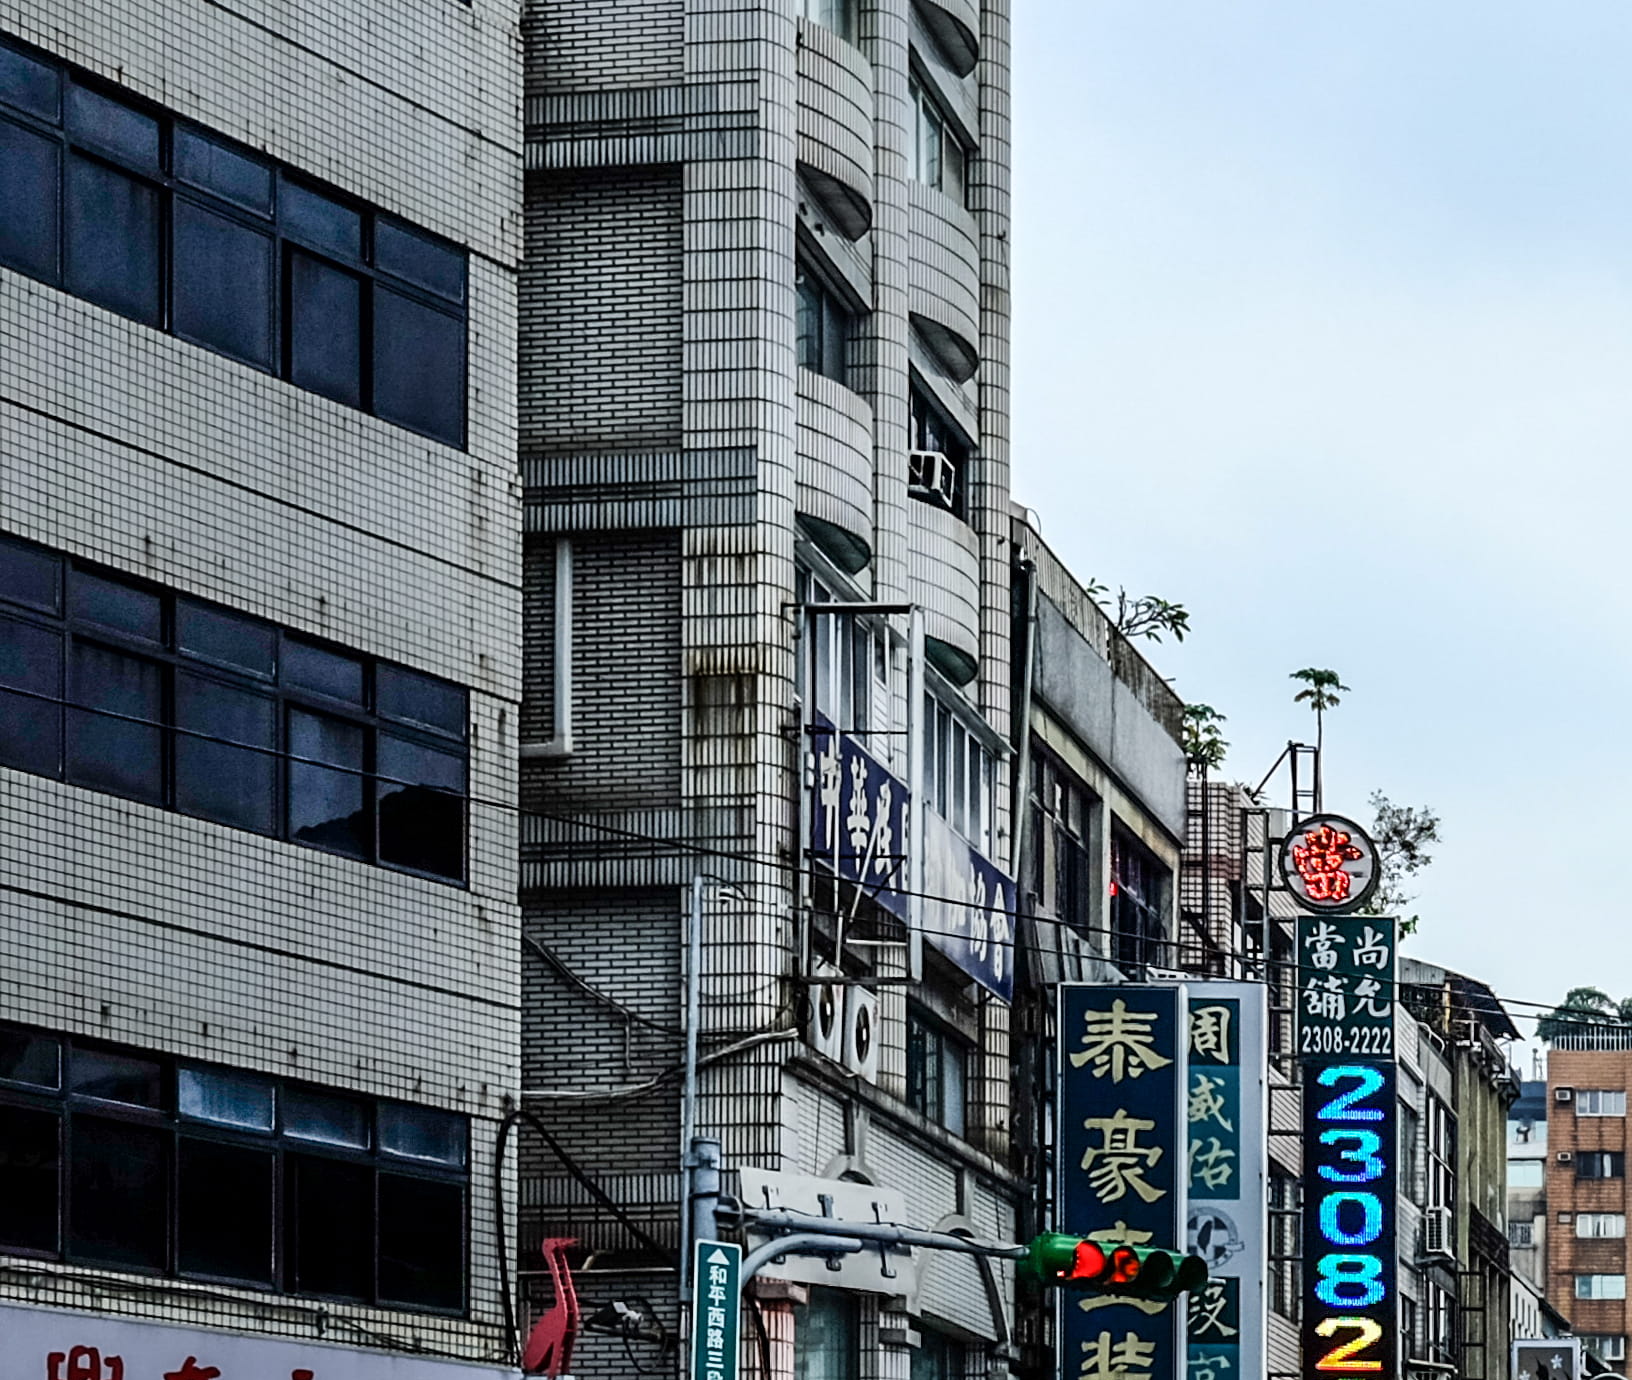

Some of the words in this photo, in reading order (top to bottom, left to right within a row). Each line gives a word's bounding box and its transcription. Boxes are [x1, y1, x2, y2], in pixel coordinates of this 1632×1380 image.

[1352, 926, 1391, 1019] 尚允
[1301, 1026, 1392, 1053] 2308-2222
[1188, 1006, 1233, 1191] 周威佑
